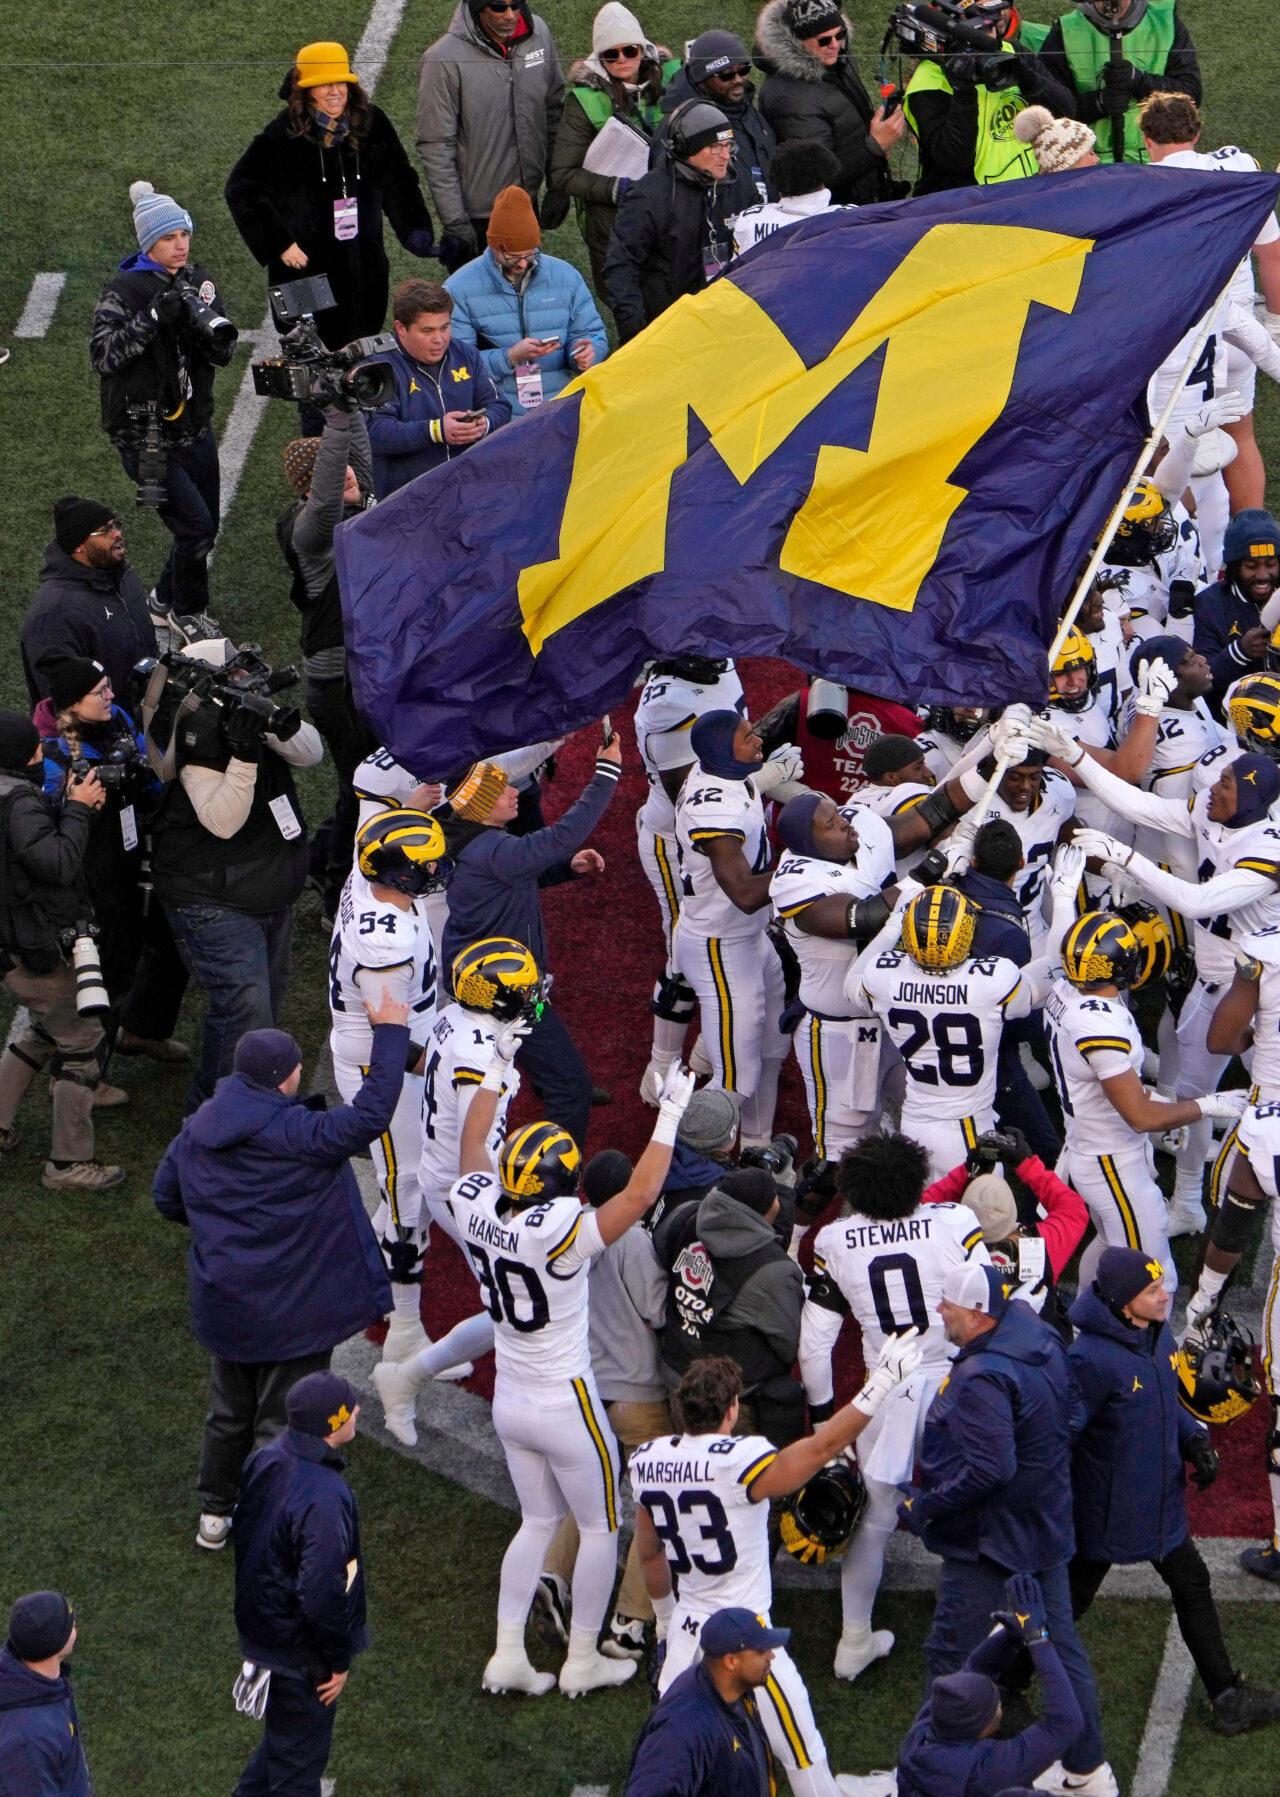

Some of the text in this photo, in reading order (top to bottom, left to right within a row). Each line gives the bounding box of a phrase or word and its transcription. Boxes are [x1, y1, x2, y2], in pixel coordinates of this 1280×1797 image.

[450, 366, 471, 382] M
[517, 224, 1095, 656] M
[833, 758, 868, 777] TEA
[686, 787, 723, 806] 42
[359, 911, 398, 935] 54
[893, 982, 969, 1005] JOHNSON
[1080, 999, 1112, 1014] 41
[858, 1027, 878, 1043] M
[888, 1007, 985, 1087] 28
[468, 1214, 520, 1255] HANSEN
[846, 1219, 932, 1249] STEWART
[1145, 1258, 1164, 1281] M
[868, 1253, 930, 1339] 0
[328, 1404, 351, 1432] M
[636, 1461, 716, 1484] MARSHALL
[640, 1490, 738, 1576] 83
[682, 1616, 700, 1637] M
